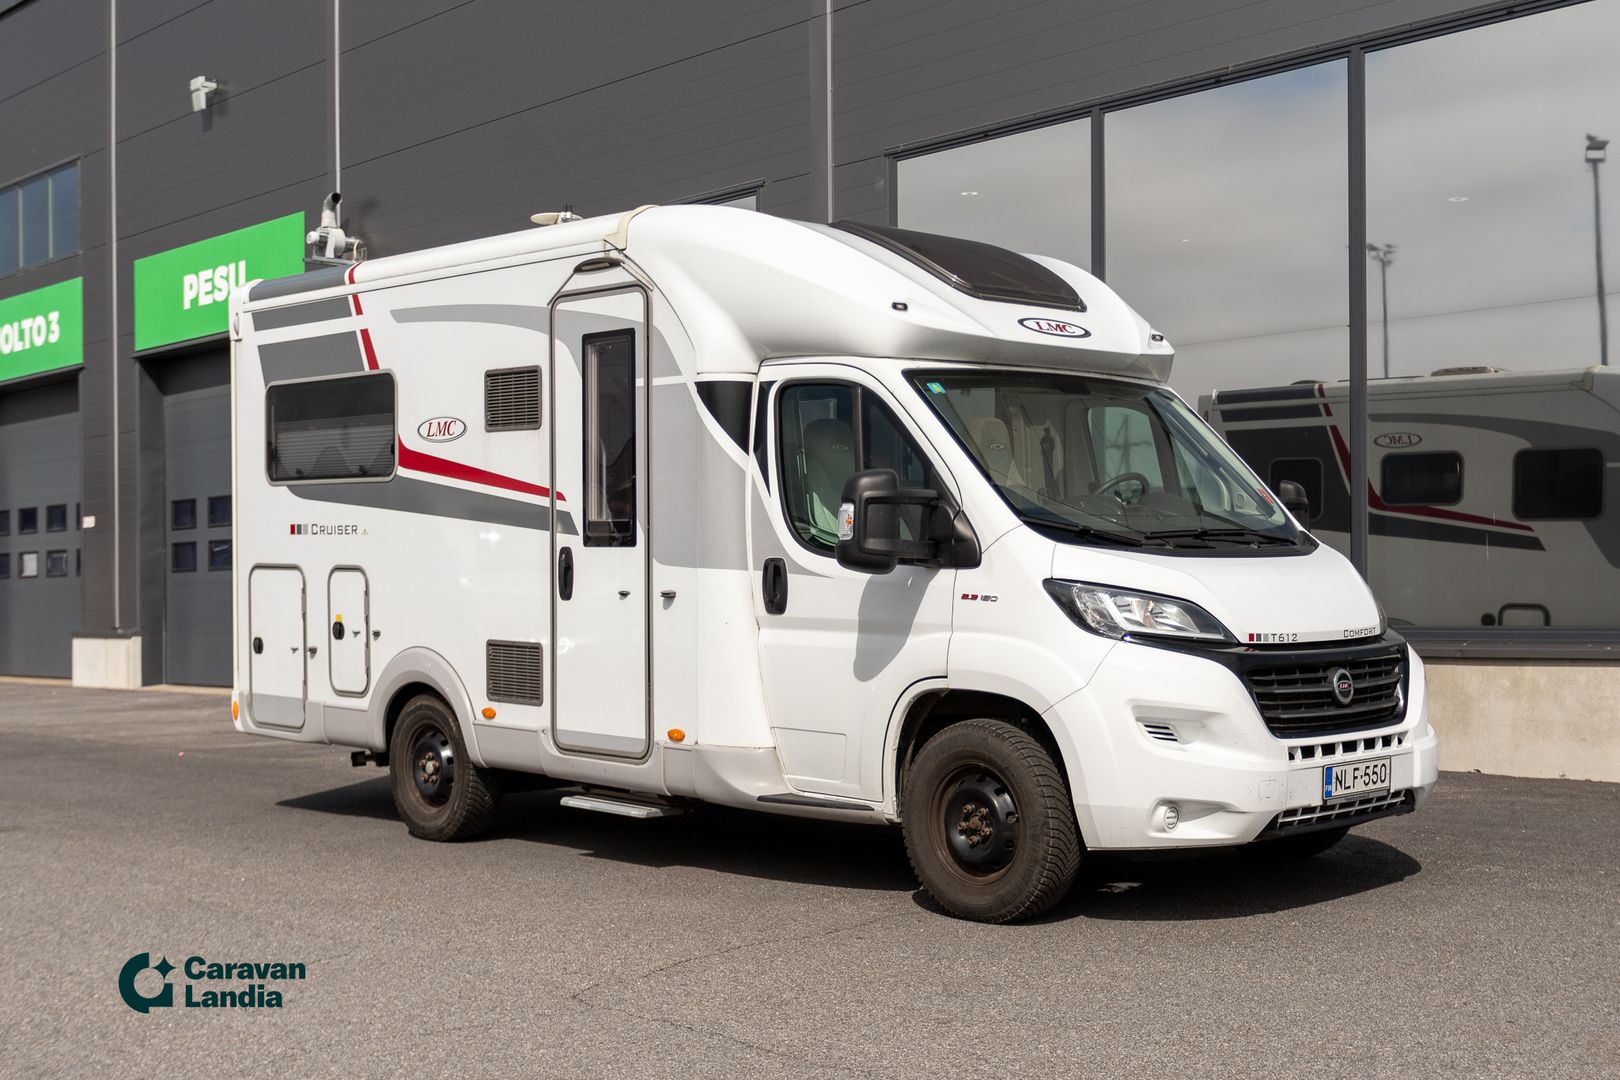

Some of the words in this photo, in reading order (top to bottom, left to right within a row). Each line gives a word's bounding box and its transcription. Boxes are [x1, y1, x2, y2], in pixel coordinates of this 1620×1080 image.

[183, 260, 246, 310] PESU
[0, 315, 47, 355] OLTO
[48, 311, 60, 344] 3
[1033, 320, 1076, 334] LMC
[426, 420, 457, 437] LMC
[311, 523, 358, 535] CRUISER
[1270, 633, 1298, 642] T612
[1343, 626, 1377, 639] COMFORT
[1335, 763, 1387, 792] NLF-550
